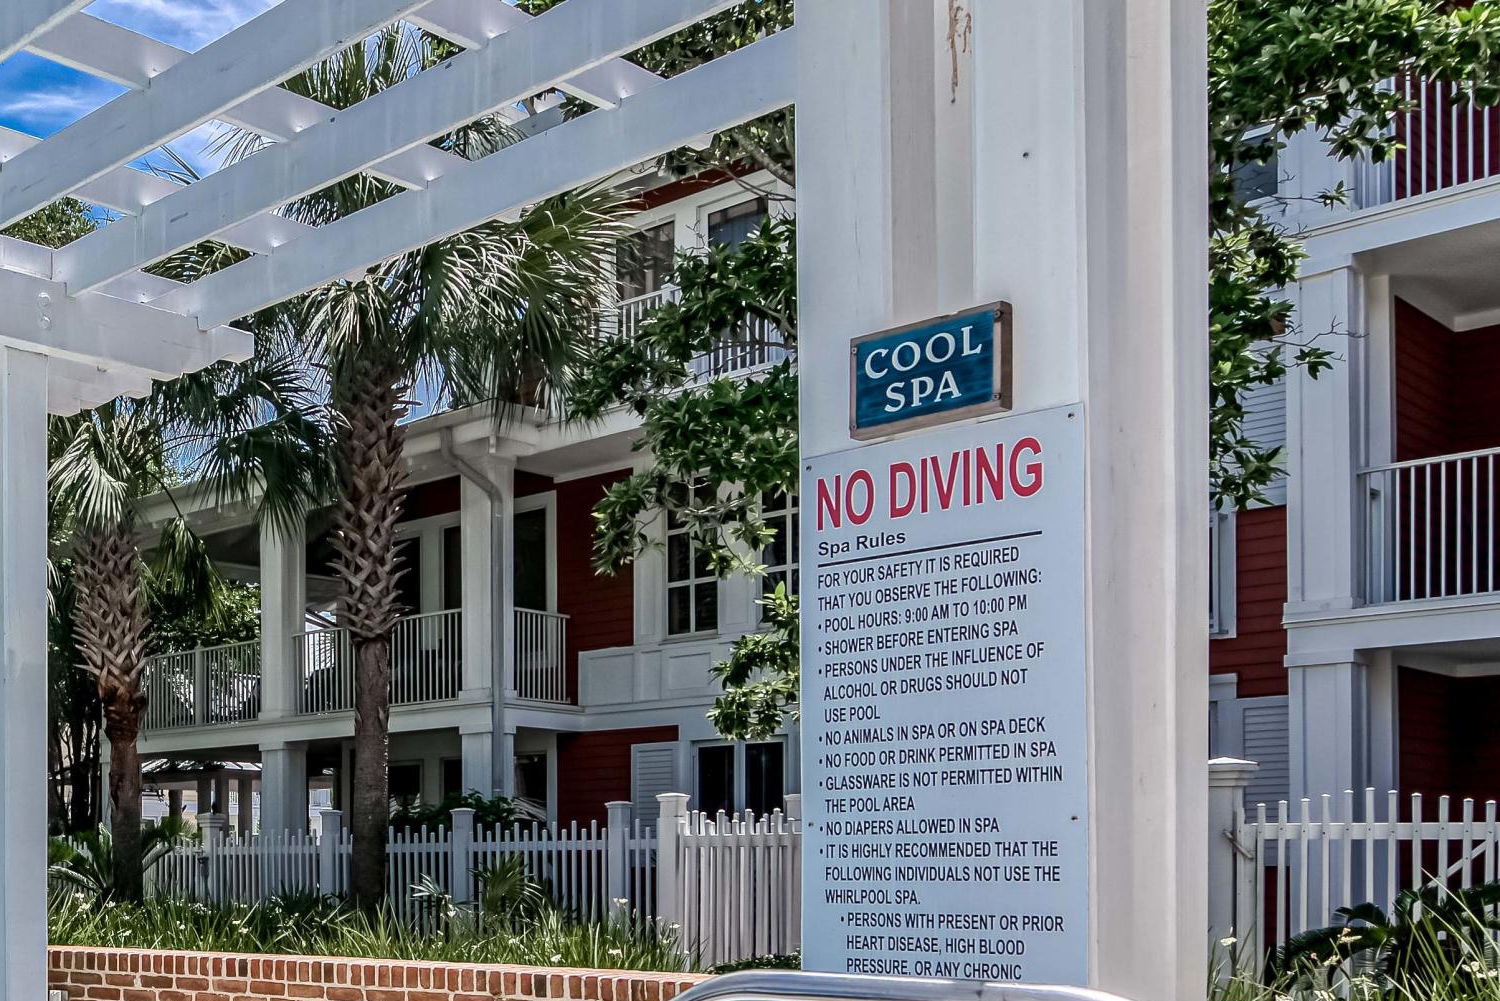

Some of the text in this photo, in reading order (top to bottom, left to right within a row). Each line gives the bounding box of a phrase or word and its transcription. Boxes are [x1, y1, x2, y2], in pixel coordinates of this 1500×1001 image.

[864, 326, 982, 379] COOL
[884, 371, 962, 412] SPA
[816, 437, 1044, 531] NO DIVING
[818, 532, 906, 558] Spa Rules
[818, 547, 1019, 589] FOR YOUR SAFETY IT IS REQUIRED
[818, 569, 1041, 611] THAT YOU OBSERVE THE FOLLOWING:
[825, 595, 1026, 633] POOL HOURS: 9:00 AM TO 10:00 PM
[825, 620, 1018, 655] SHOWER BEFORE ENTERING SPA
[826, 642, 1044, 678] PERSONS UNDER THE INFLUENCE OF
[824, 669, 1028, 700] ALCOHOL OR DRUGS SHOULD NOT
[825, 706, 880, 723] USE POOL
[826, 717, 1045, 745] NO ANIMALS IN SPA OR ON SPA DECK
[826, 741, 1056, 768] NO FOOD OR DRINK PERMITTED IN SPA
[826, 766, 1062, 790] GLASSWARE IS NOT PERMITTED WITHIN
[825, 796, 914, 813] THE POOL AREA
[827, 818, 999, 835] NO DIAPERS ALLOWED IN SPA
[827, 841, 1058, 858] IT IS HIGHLY RECOMMENDED THAT THE
[826, 866, 1060, 881] FOLLOWING INDIVIDUALS NOT USE THE
[825, 889, 920, 904] WHIRLPOOL SPA.
[848, 912, 1064, 931] PERSONS WITH PRESENT OR PRIOR
[847, 935, 1024, 955] HEART DISEASE, HIGH BLOOD
[915, 961, 932, 976] OR
[935, 962, 960, 977] ANY
[964, 963, 1021, 980] CHRONIC
